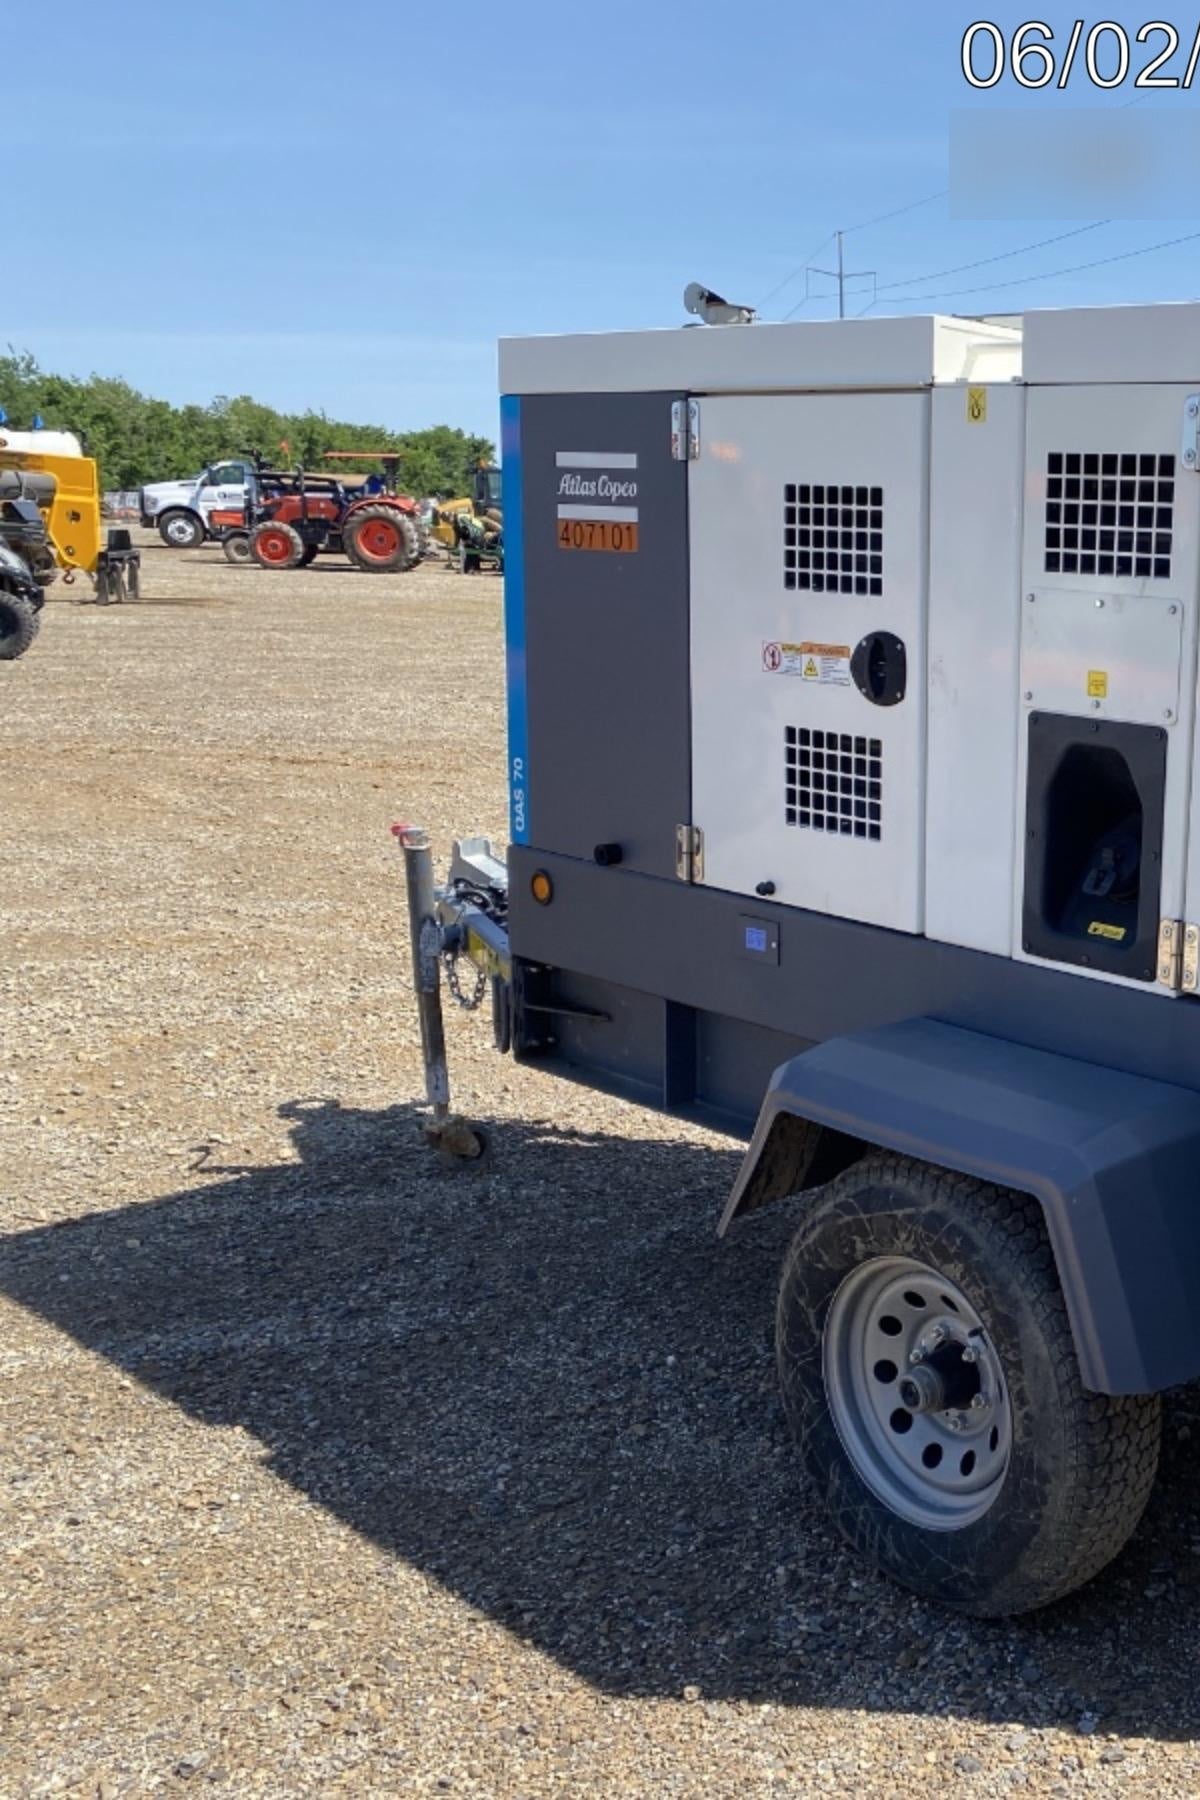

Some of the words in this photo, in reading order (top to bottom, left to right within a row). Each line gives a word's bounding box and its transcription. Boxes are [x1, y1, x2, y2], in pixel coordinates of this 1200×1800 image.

[560, 521, 634, 550] 407101
[513, 757, 524, 782] 70
[514, 788, 525, 832] QAS
